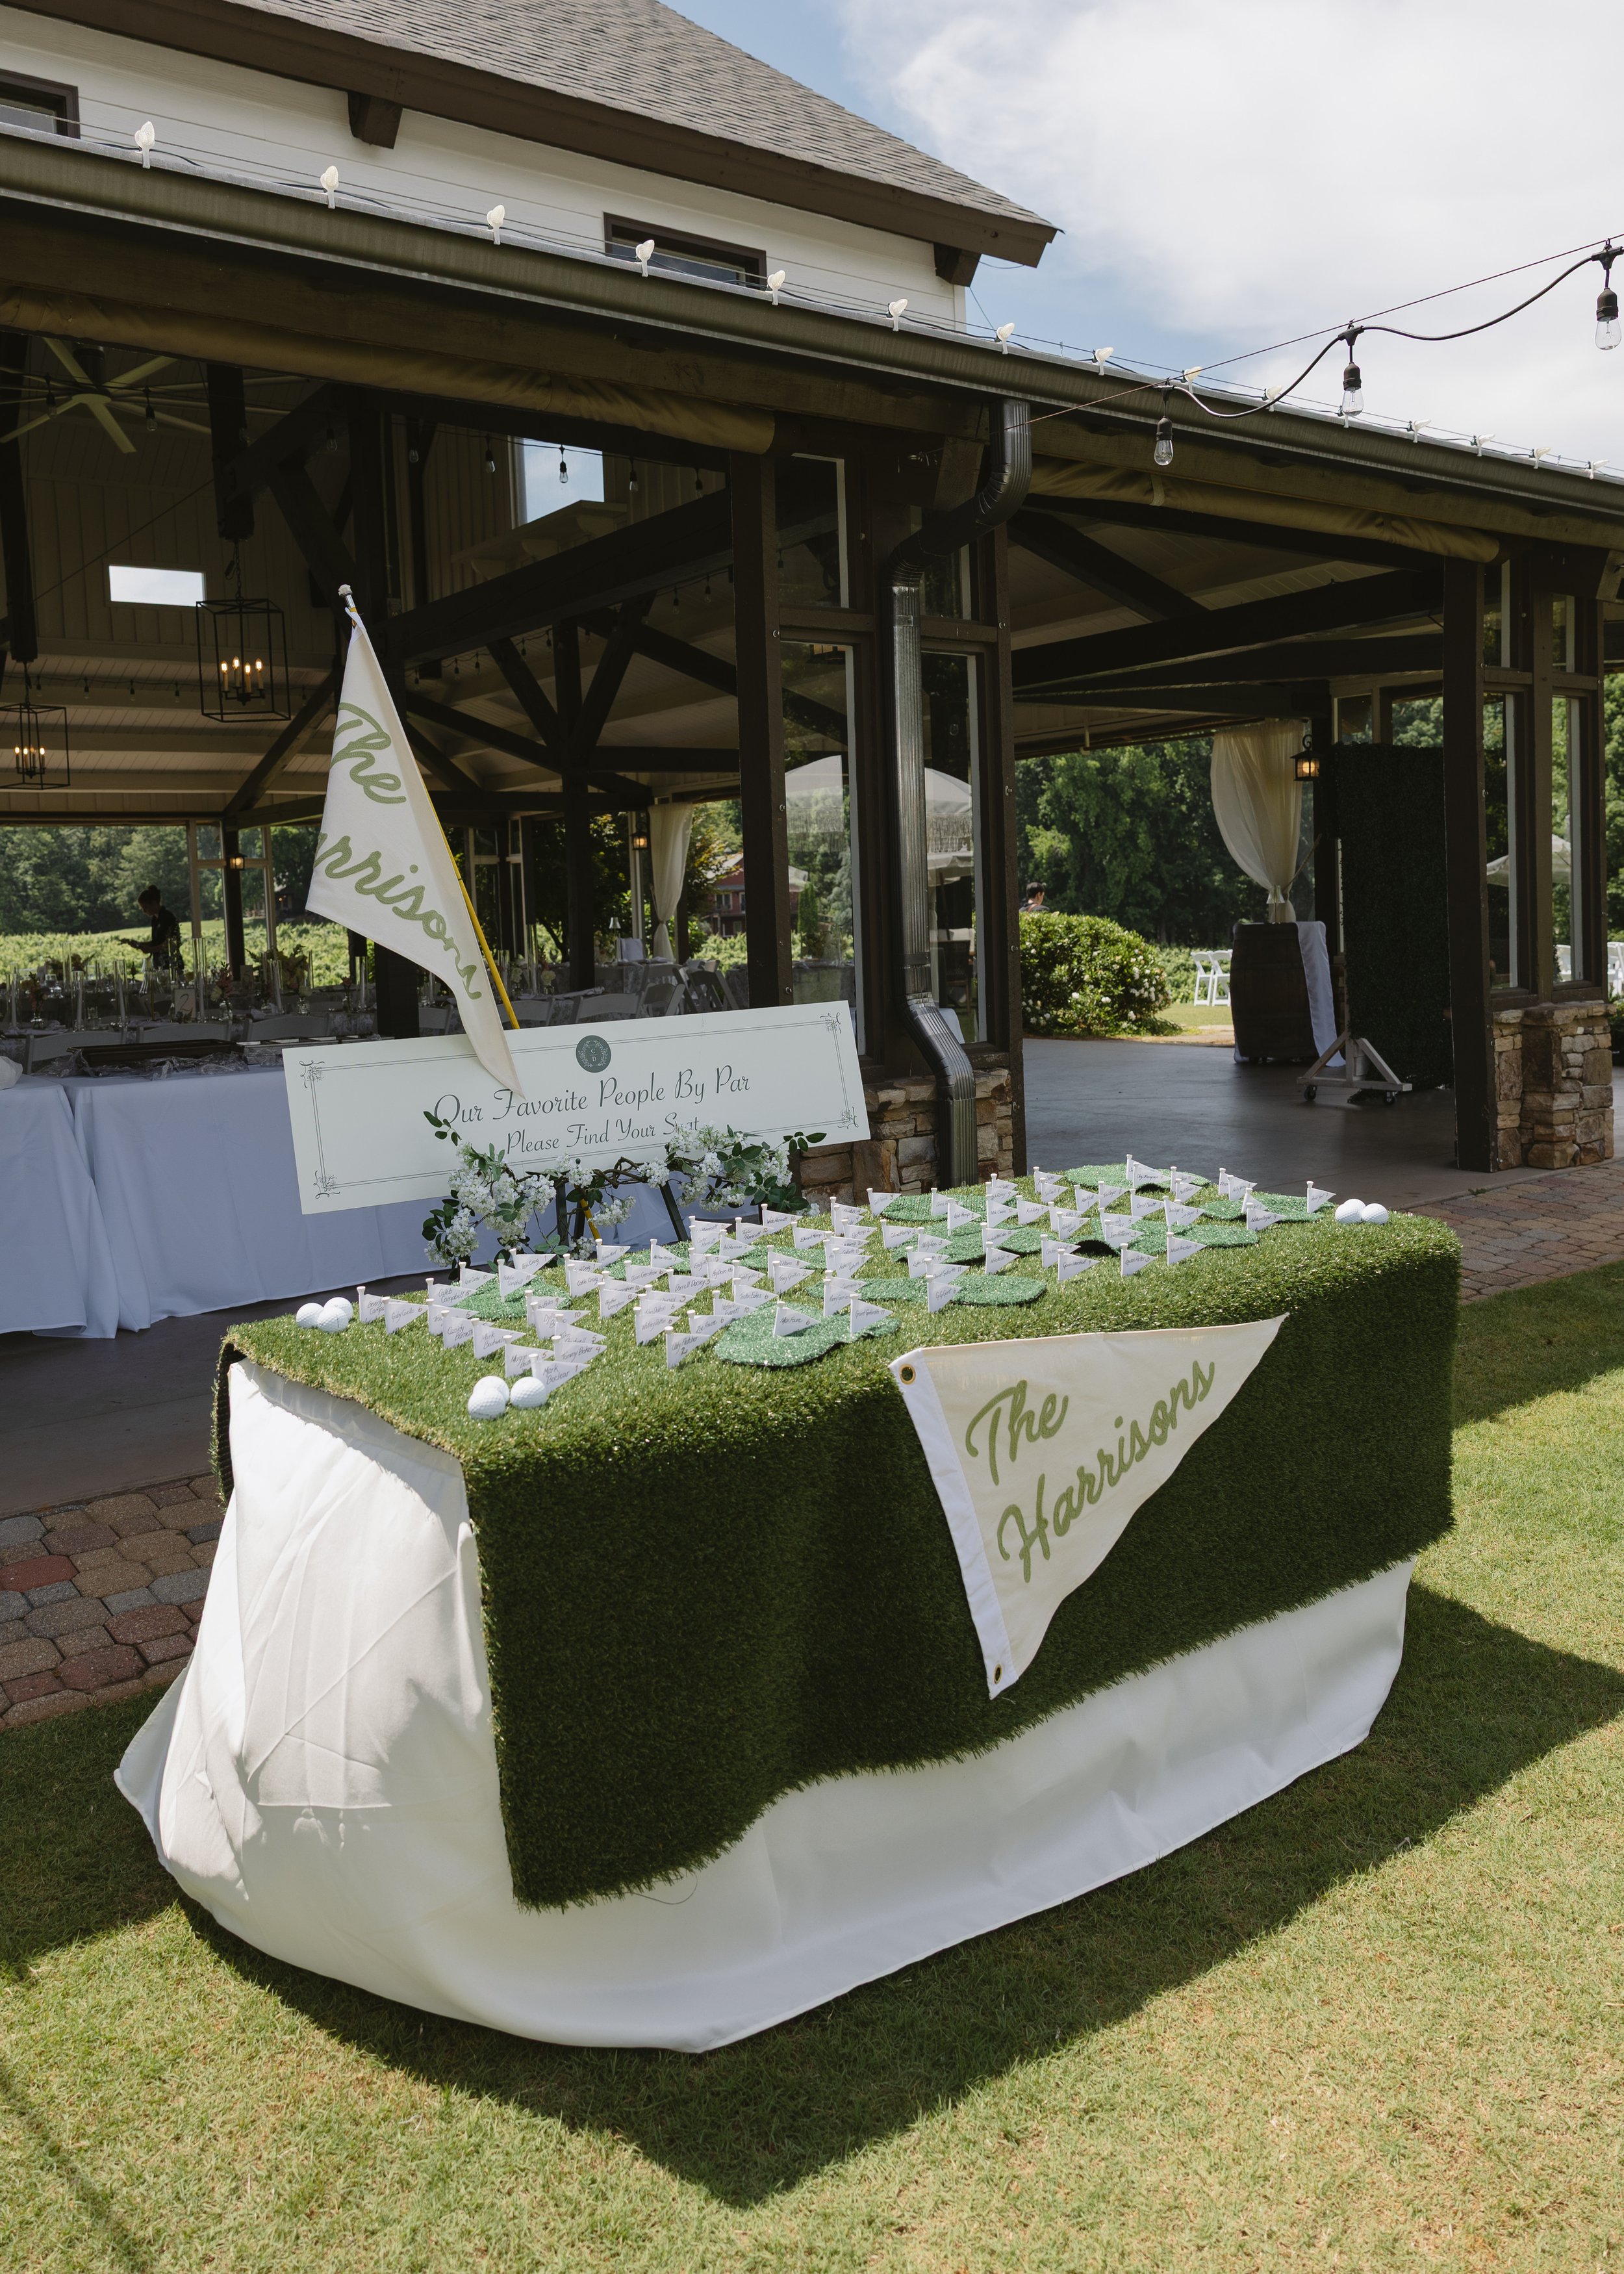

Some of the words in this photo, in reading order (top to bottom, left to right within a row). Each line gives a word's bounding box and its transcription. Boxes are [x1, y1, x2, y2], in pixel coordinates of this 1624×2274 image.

[313, 831, 483, 1000] rrisons
[434, 1095, 483, 1123] Our
[493, 1089, 588, 1119] Favorite
[600, 1072, 665, 1111] People
[674, 1069, 704, 1104] By
[717, 1065, 750, 1093] Par
[507, 1130, 559, 1154] Please
[566, 1119, 609, 1147] Find
[616, 1118, 656, 1141] Your
[543, 1364, 559, 1376] Mark
[680, 1346, 688, 1355] 2
[965, 1379, 1069, 1486] The
[996, 1360, 1215, 1583] Harrisons
